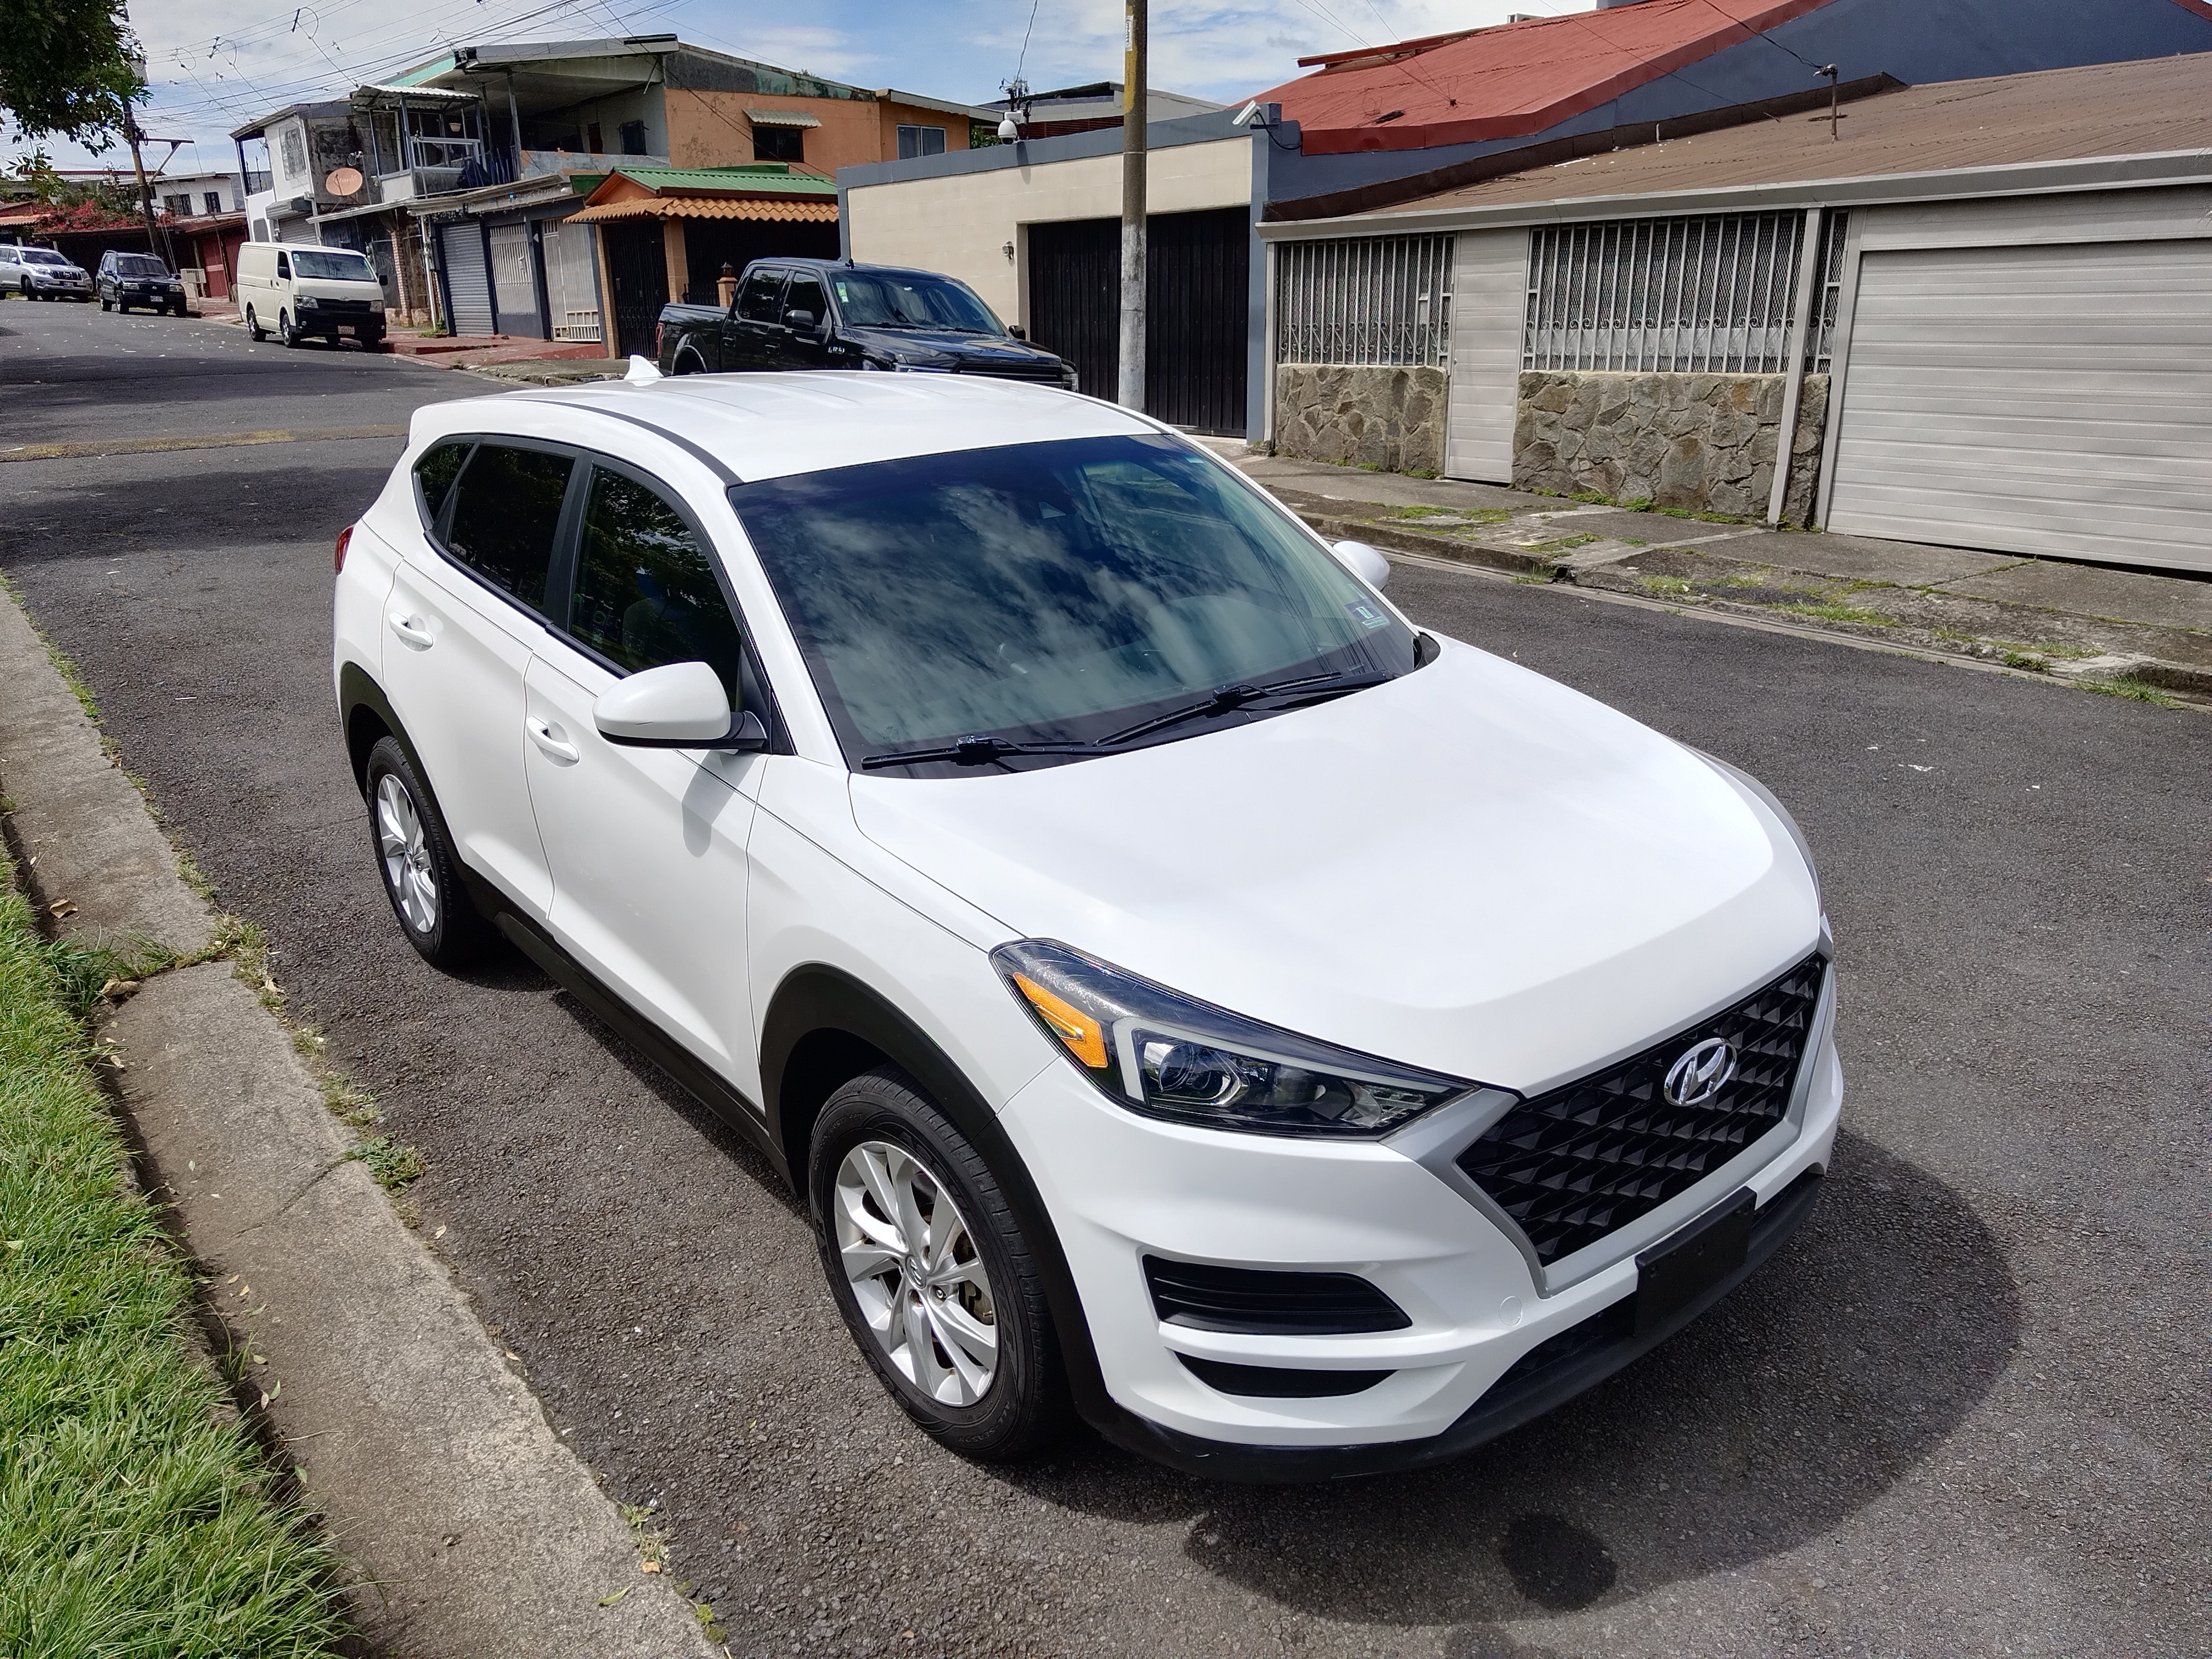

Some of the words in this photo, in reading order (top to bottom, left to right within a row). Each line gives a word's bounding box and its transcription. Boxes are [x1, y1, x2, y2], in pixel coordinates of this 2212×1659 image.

[816, 1216, 909, 1410] GOODYEAR
[898, 1129, 1014, 1352] ASSURANCE
[958, 1399, 1010, 1442] ALL-SEASON
